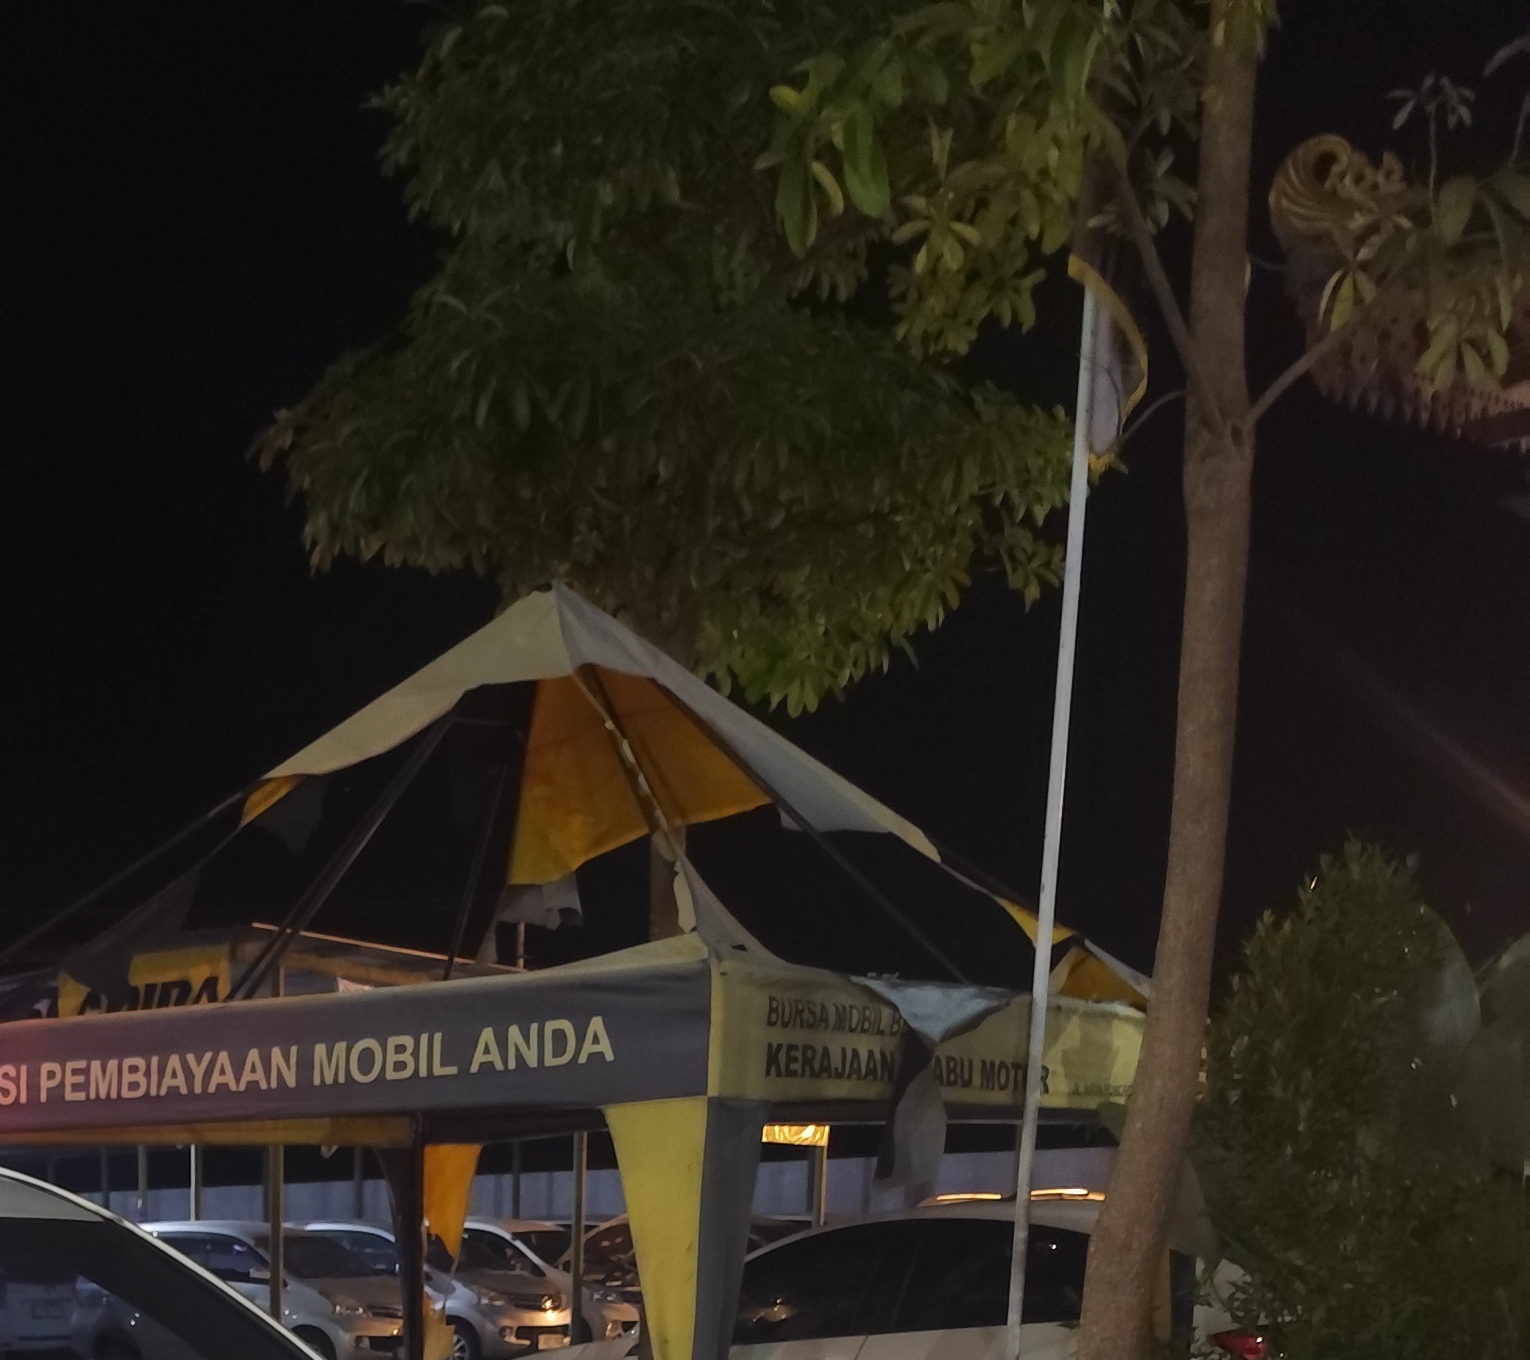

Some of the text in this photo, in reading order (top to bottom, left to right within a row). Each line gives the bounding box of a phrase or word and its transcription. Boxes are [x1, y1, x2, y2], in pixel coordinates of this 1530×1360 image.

[766, 995, 829, 1030] BURSA
[39, 1045, 299, 1104] PEMBIAYAAN
[313, 1032, 459, 1087] MOBIL
[469, 1015, 615, 1074] ANDA
[765, 1042, 894, 1082] KERAJAAN
[980, 1058, 1049, 1095] MOTR
